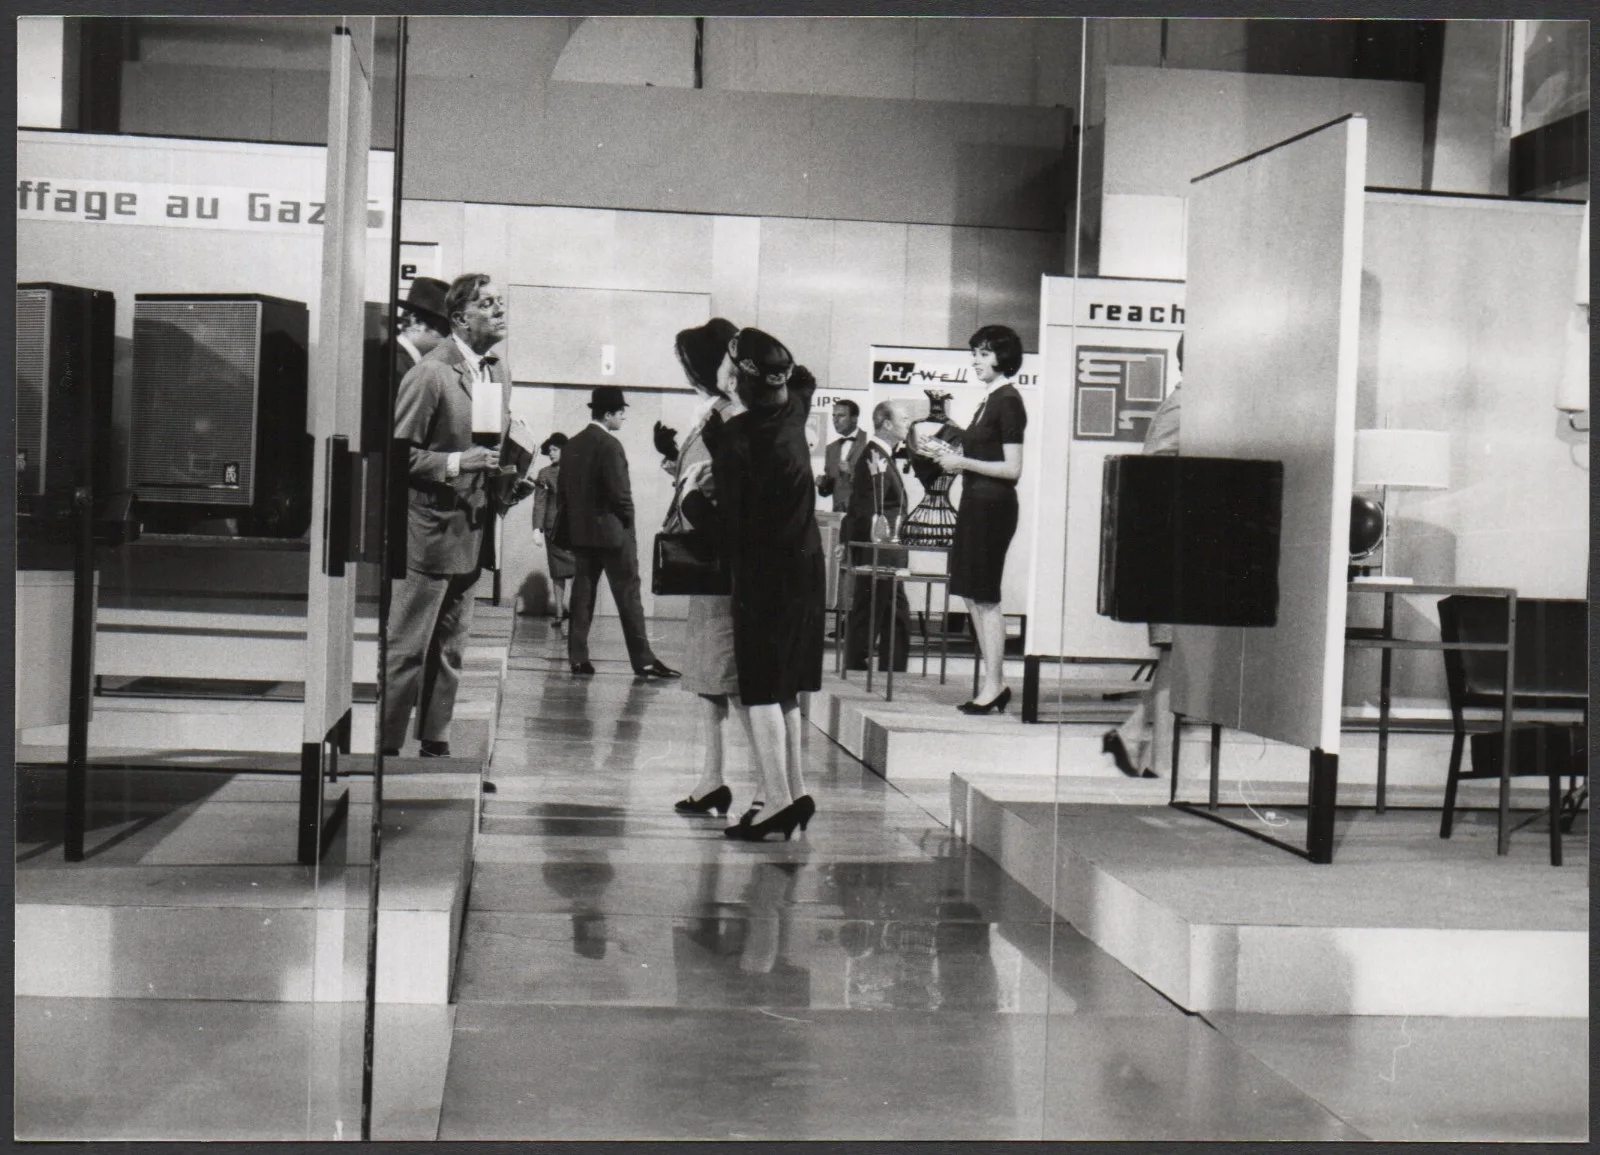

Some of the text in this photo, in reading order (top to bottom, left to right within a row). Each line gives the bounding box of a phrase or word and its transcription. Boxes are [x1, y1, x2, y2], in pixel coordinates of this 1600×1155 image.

[17, 180, 325, 225] ffage au Gaz
[1089, 303, 1185, 325] reach
[810, 396, 841, 407] IPS
